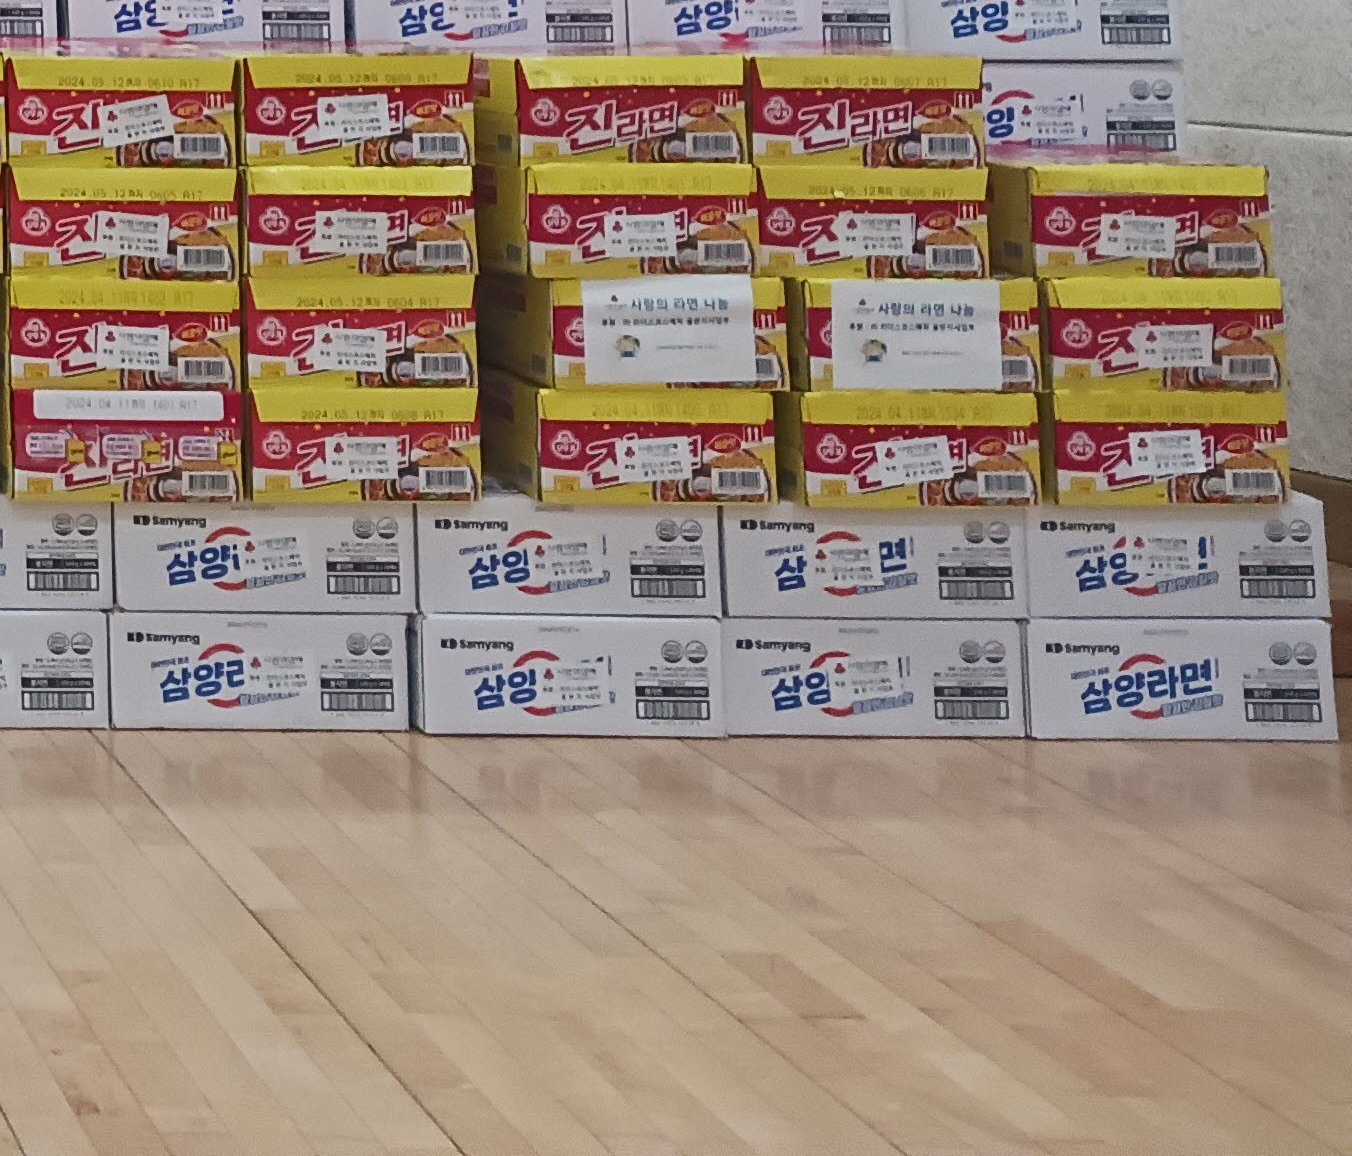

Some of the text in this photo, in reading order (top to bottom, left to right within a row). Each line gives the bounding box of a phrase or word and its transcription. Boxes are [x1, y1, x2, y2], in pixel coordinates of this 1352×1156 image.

[565, 99, 678, 153] 진라면
[799, 99, 913, 153] 진라면
[631, 298, 728, 312] 사랑의 라면 나눔
[879, 303, 974, 318] 사랑의 라면 나눔
[169, 546, 231, 585] 삼양
[471, 552, 529, 589] 삼양
[476, 669, 536, 710] 삼양
[774, 673, 830, 711] 삼양
[1083, 662, 1211, 715] 삼양라면
